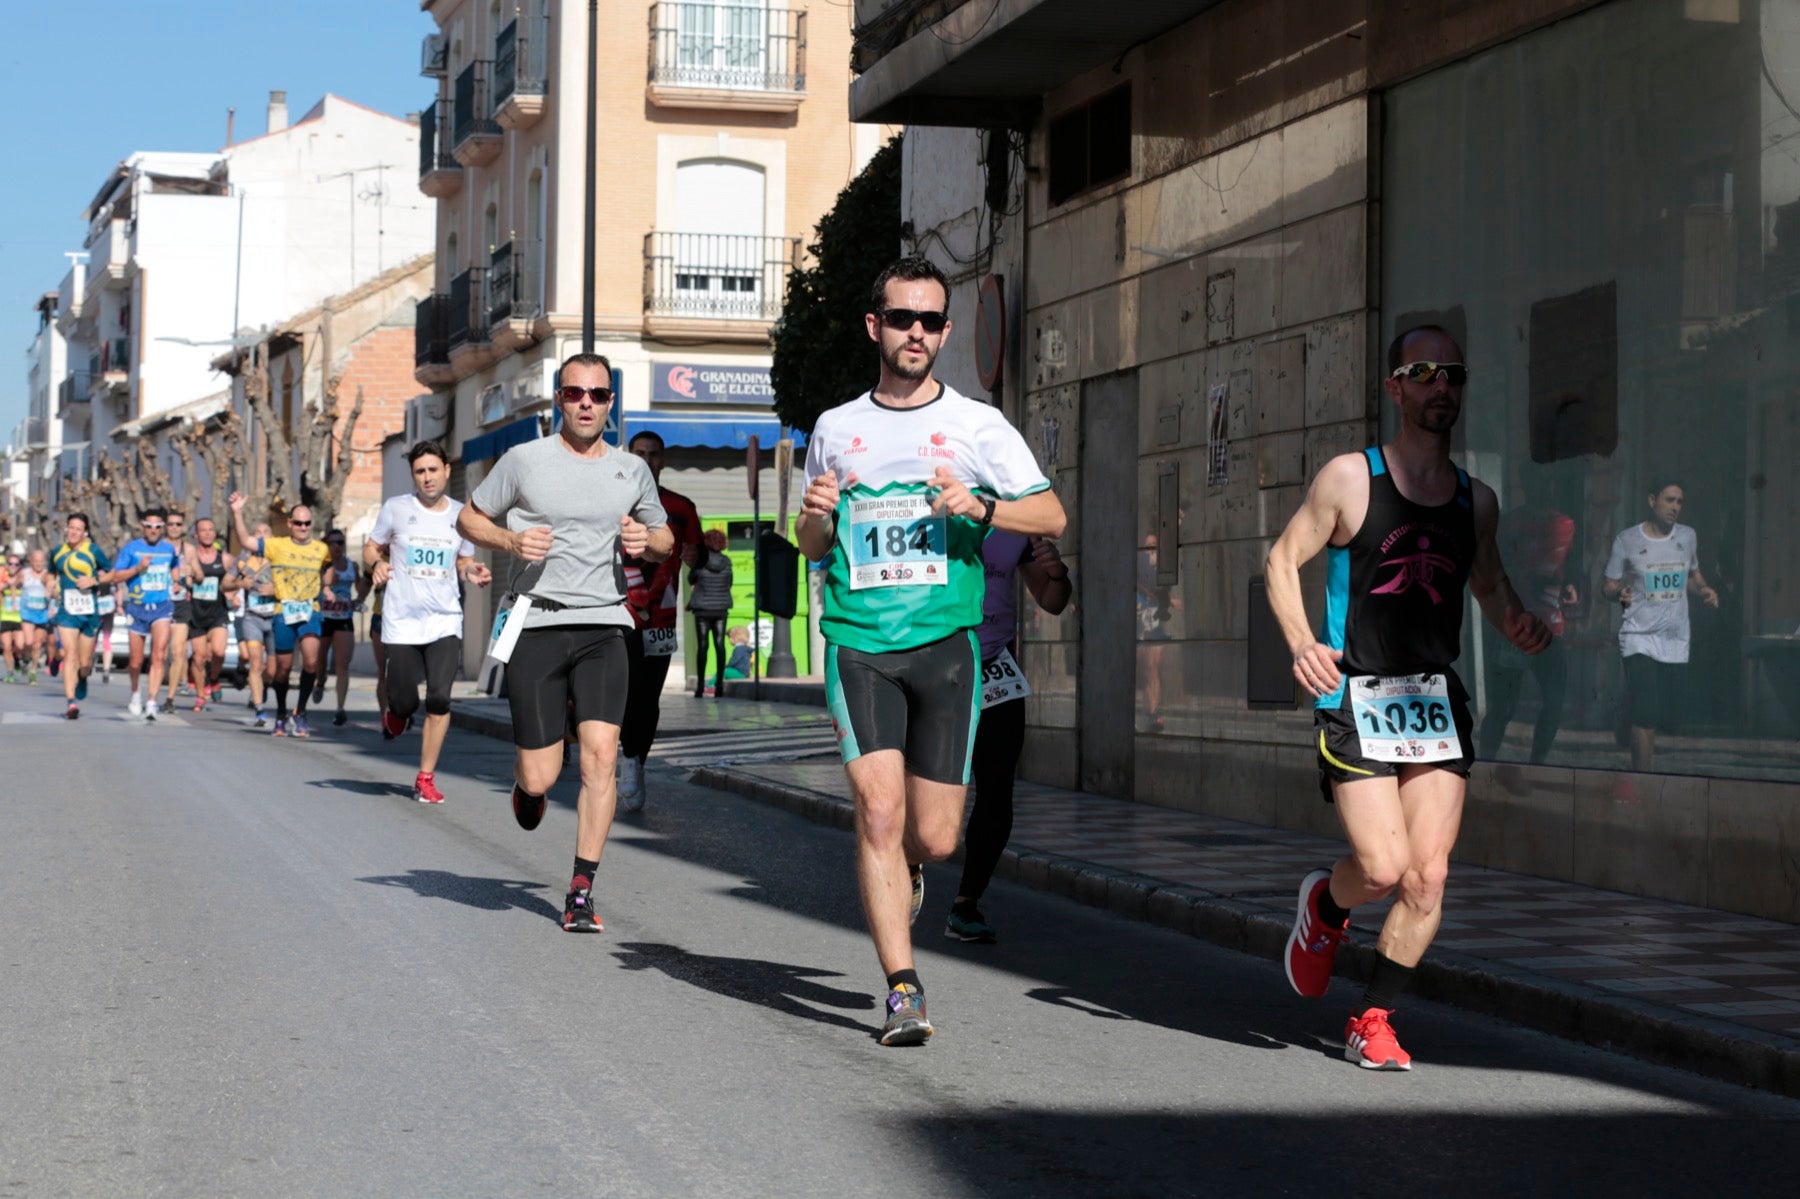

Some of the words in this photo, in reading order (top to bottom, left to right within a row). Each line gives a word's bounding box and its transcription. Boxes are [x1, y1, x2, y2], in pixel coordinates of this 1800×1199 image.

[700, 371, 771, 385] GRANADINA
[709, 383, 727, 394] DE
[869, 500, 885, 510] GRAN
[886, 499, 908, 509] PREMIO
[910, 498, 918, 508] DE
[877, 509, 914, 519] DIPUTACIÓN
[865, 524, 931, 558] 184
[414, 548, 444, 566] 301
[648, 626, 674, 643] 308
[1362, 701, 1449, 735] 1036
